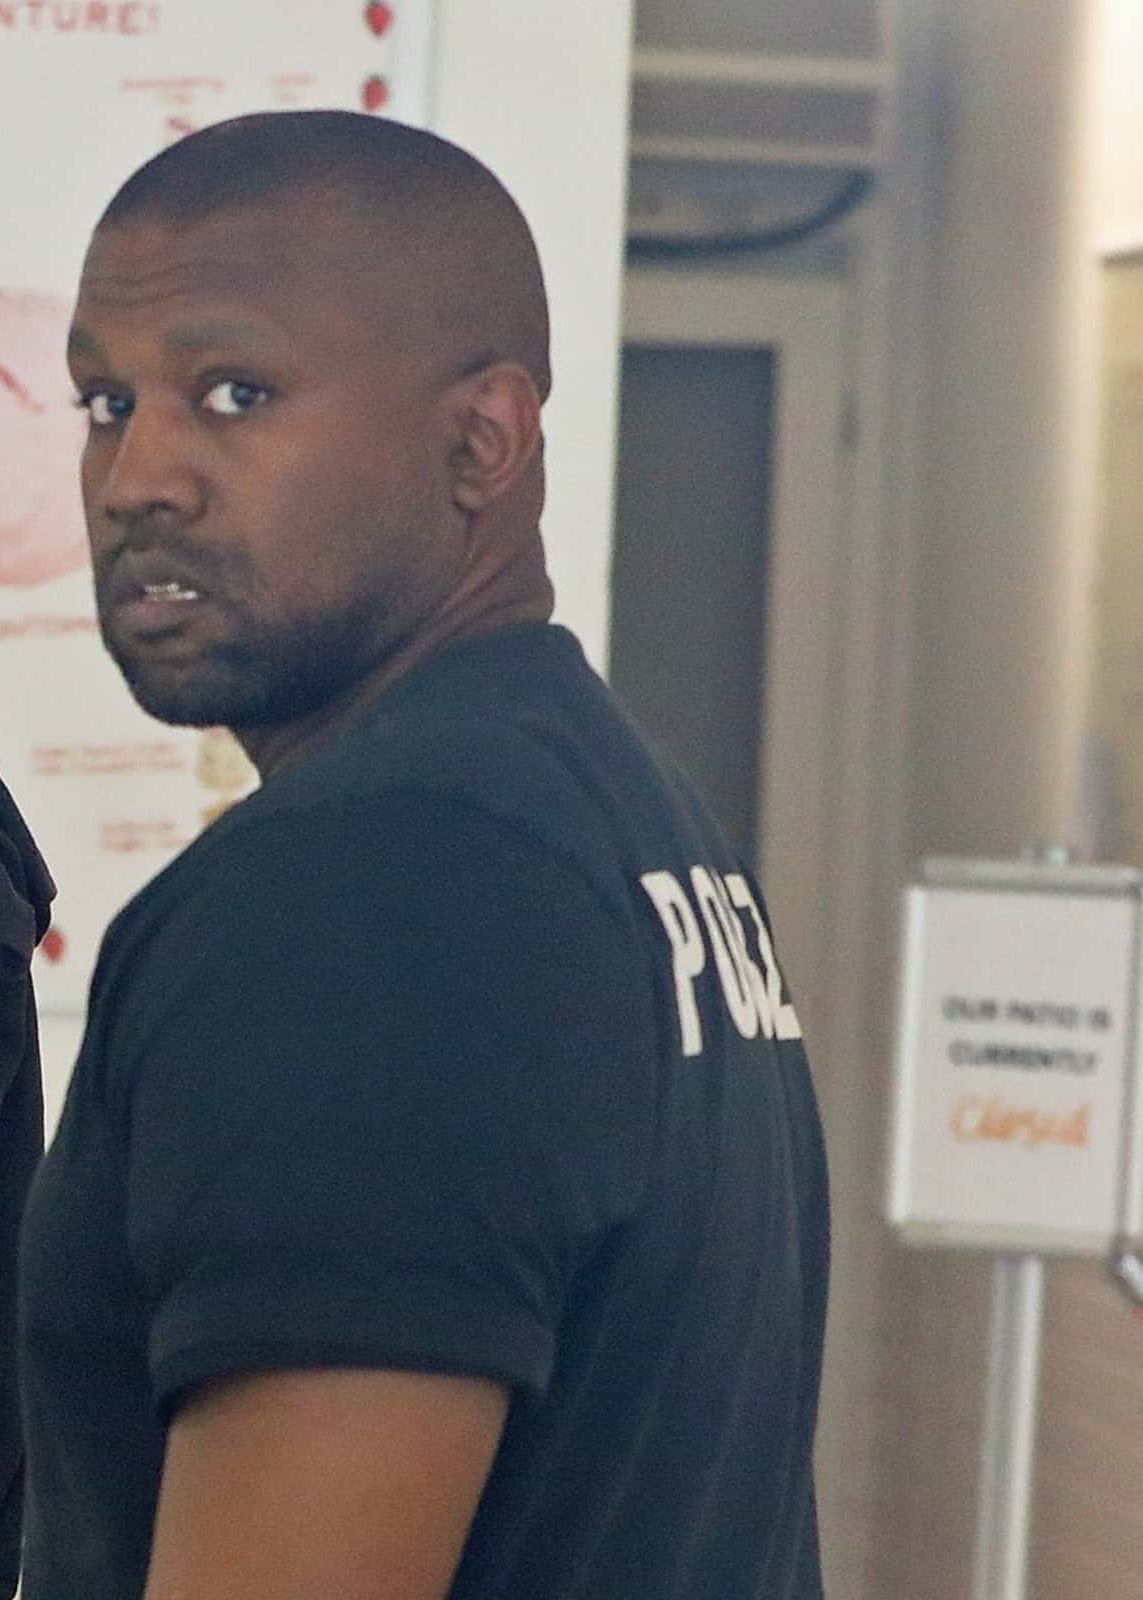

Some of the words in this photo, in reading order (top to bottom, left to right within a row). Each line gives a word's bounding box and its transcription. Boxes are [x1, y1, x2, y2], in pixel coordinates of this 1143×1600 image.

[941, 994, 997, 1023] OUR
[1007, 998, 1081, 1030] PATIO
[947, 1037, 1099, 1077] CURRENTLY
